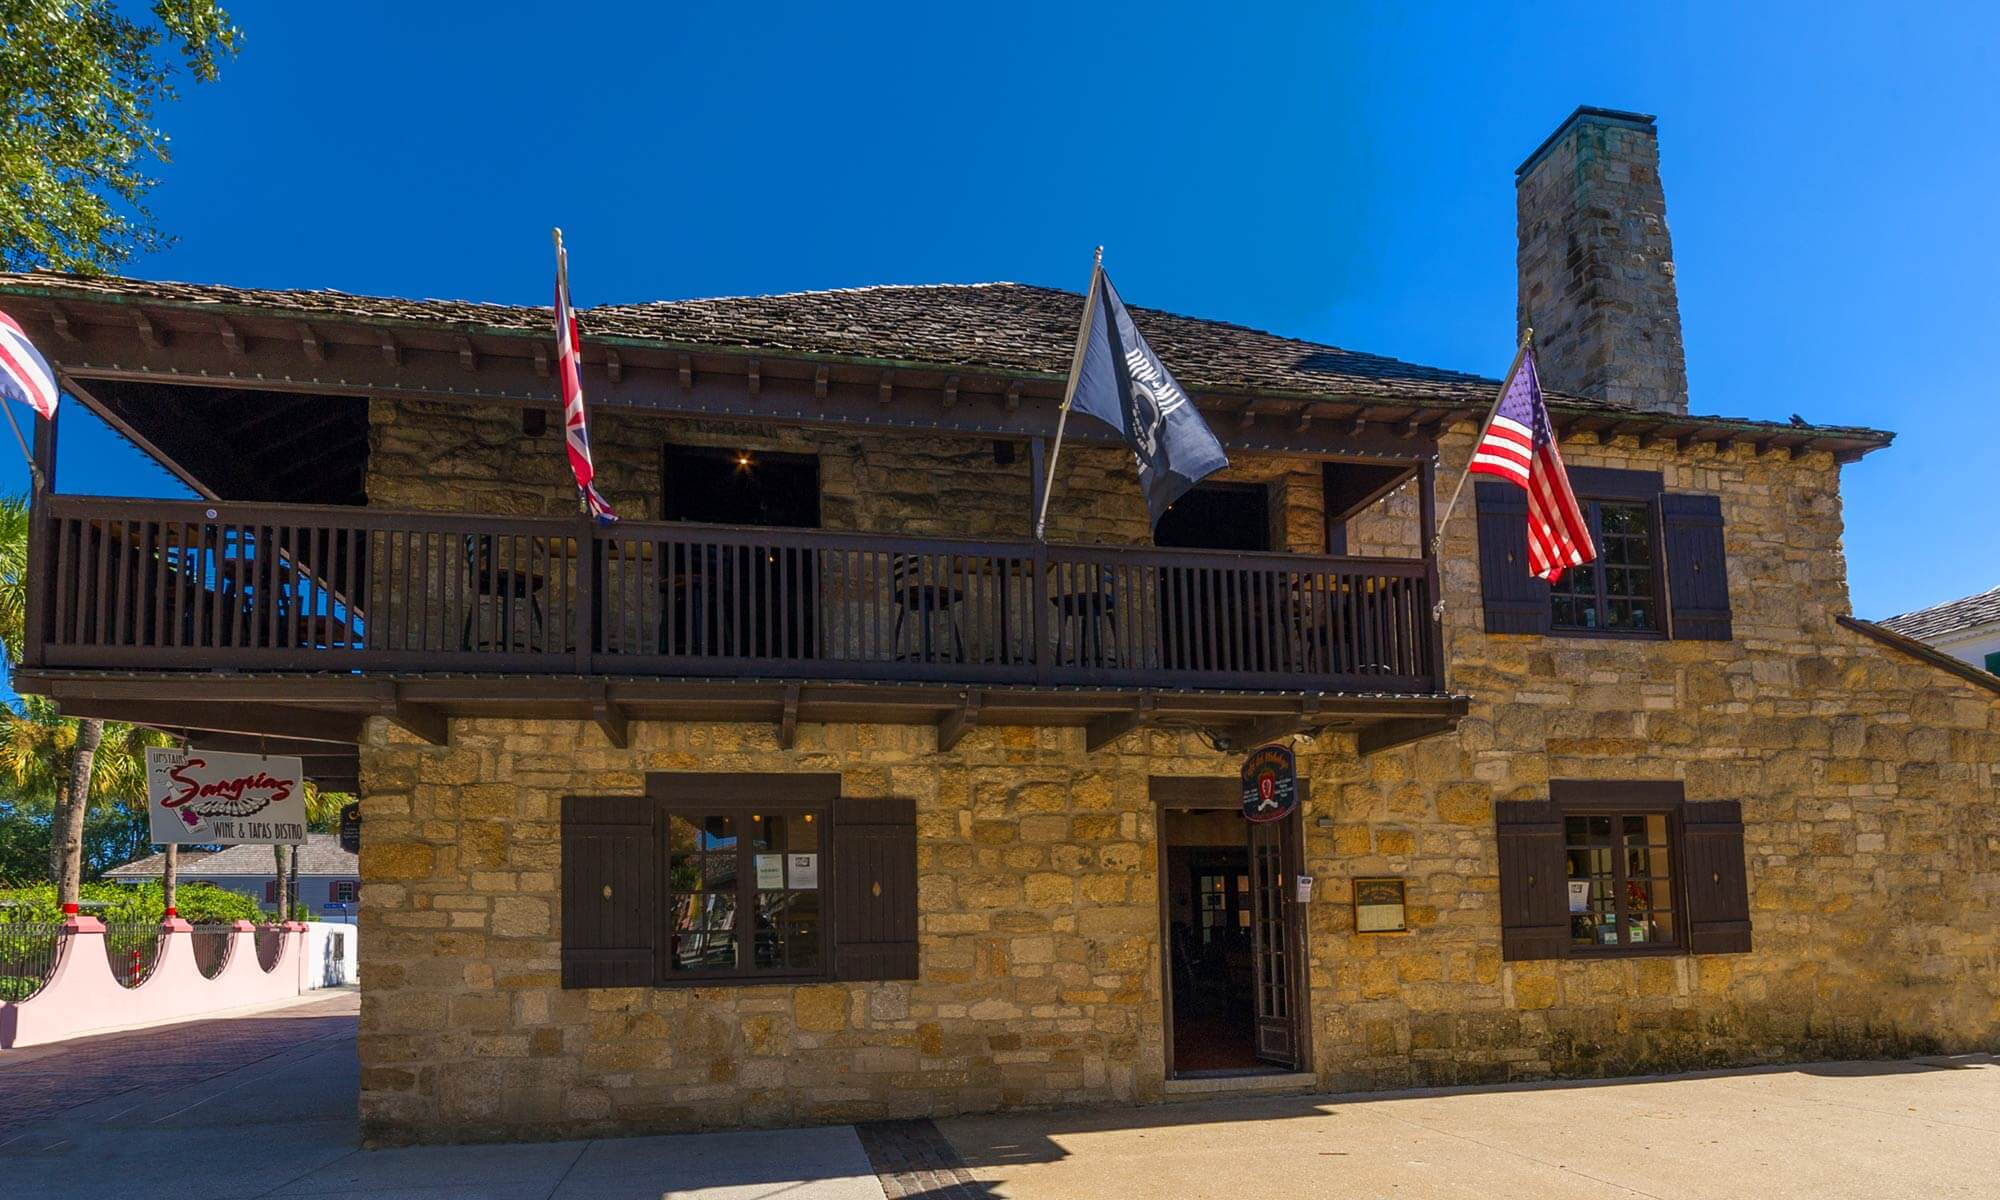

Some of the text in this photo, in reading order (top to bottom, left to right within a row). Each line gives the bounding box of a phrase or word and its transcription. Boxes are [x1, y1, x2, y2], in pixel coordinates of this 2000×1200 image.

[153, 752, 188, 766] UPSTAIRS
[213, 821, 303, 840] WINE & TAPAS BISTRO
